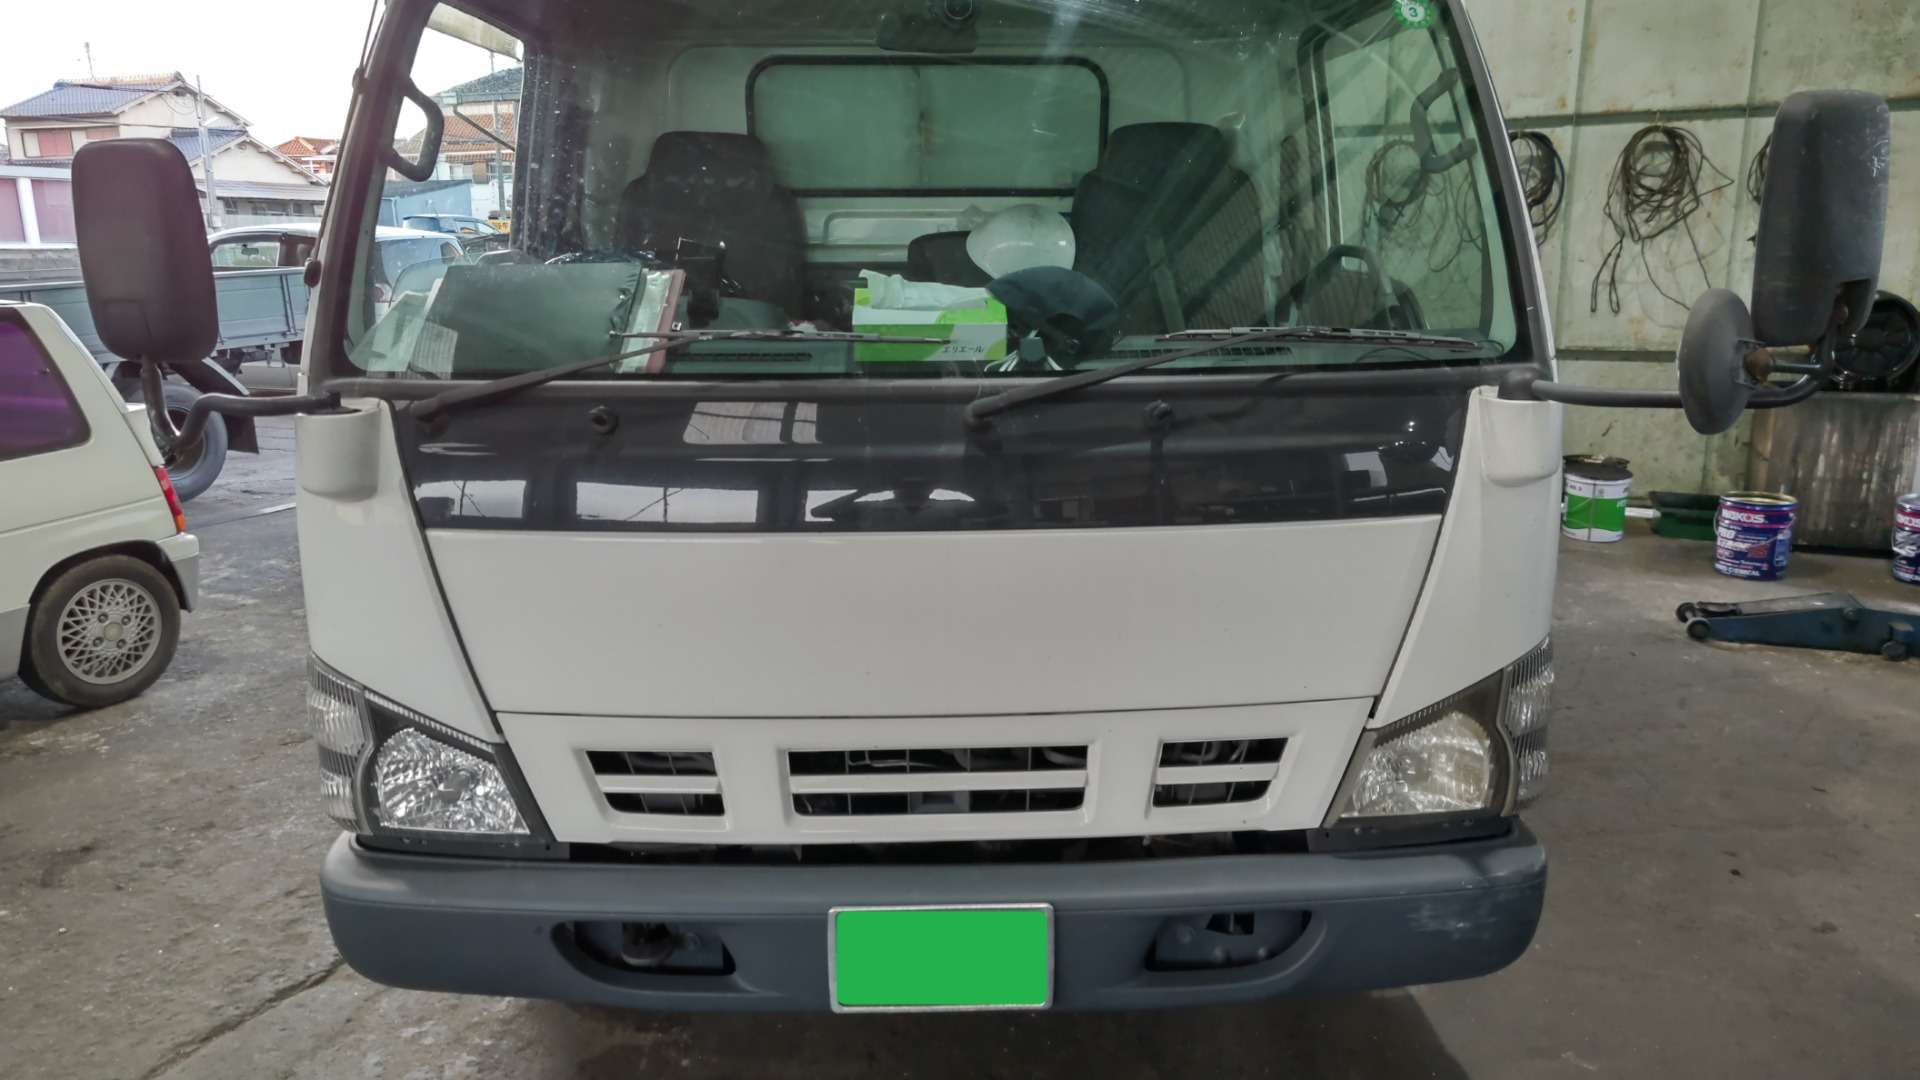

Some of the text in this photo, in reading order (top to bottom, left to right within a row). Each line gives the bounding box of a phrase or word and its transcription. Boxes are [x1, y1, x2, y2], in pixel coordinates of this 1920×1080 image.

[1408, 7, 1418, 17] 3
[943, 344, 984, 353] エリエール
